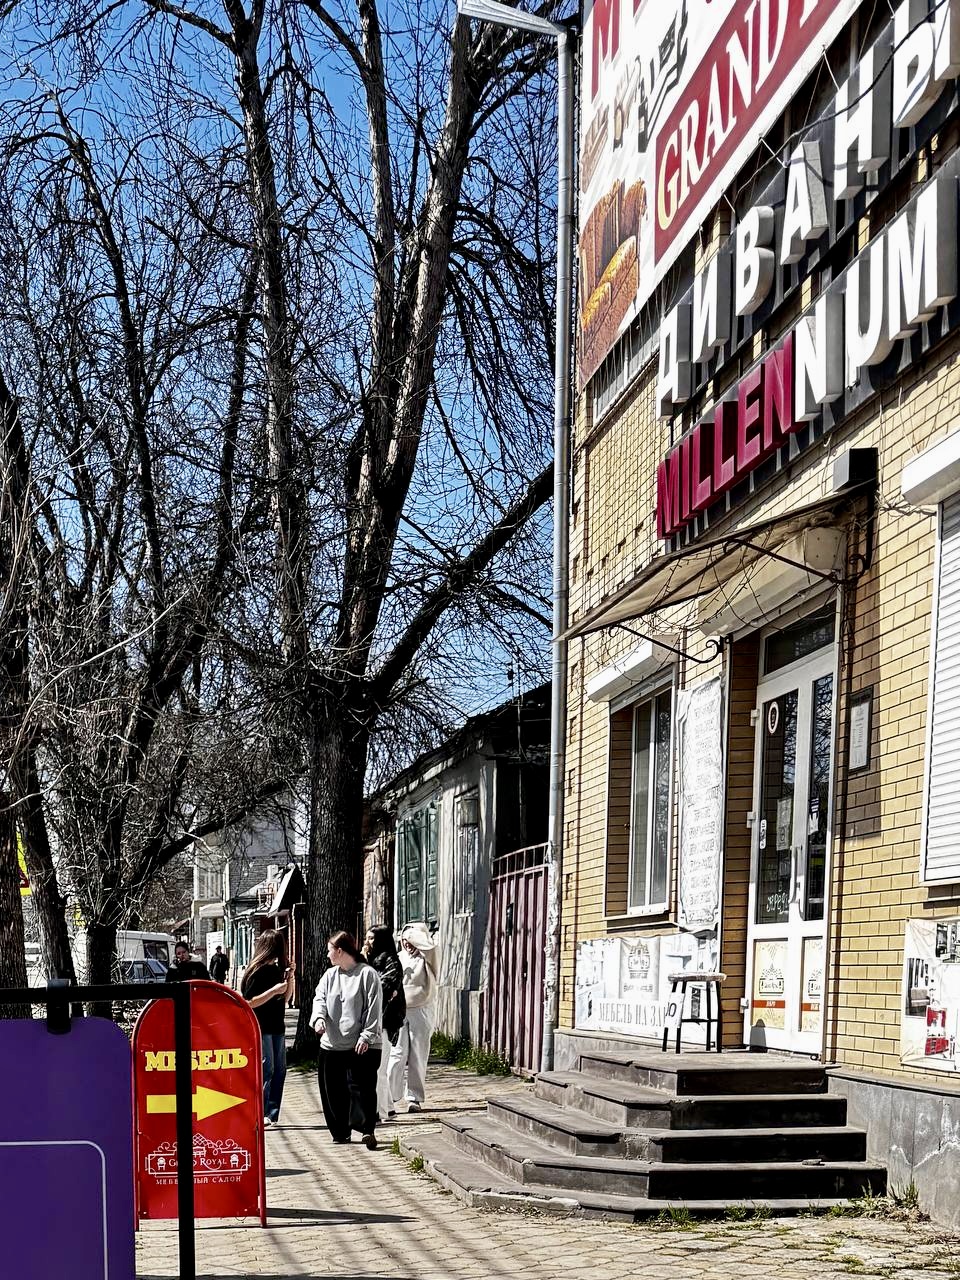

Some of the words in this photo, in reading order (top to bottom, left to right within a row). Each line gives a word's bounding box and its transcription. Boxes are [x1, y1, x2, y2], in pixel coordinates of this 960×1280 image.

[656, 0, 951, 421] ДИВАНЫ
[658, 0, 789, 231] GRAND
[212, 1175, 241, 1183] САЛОН
